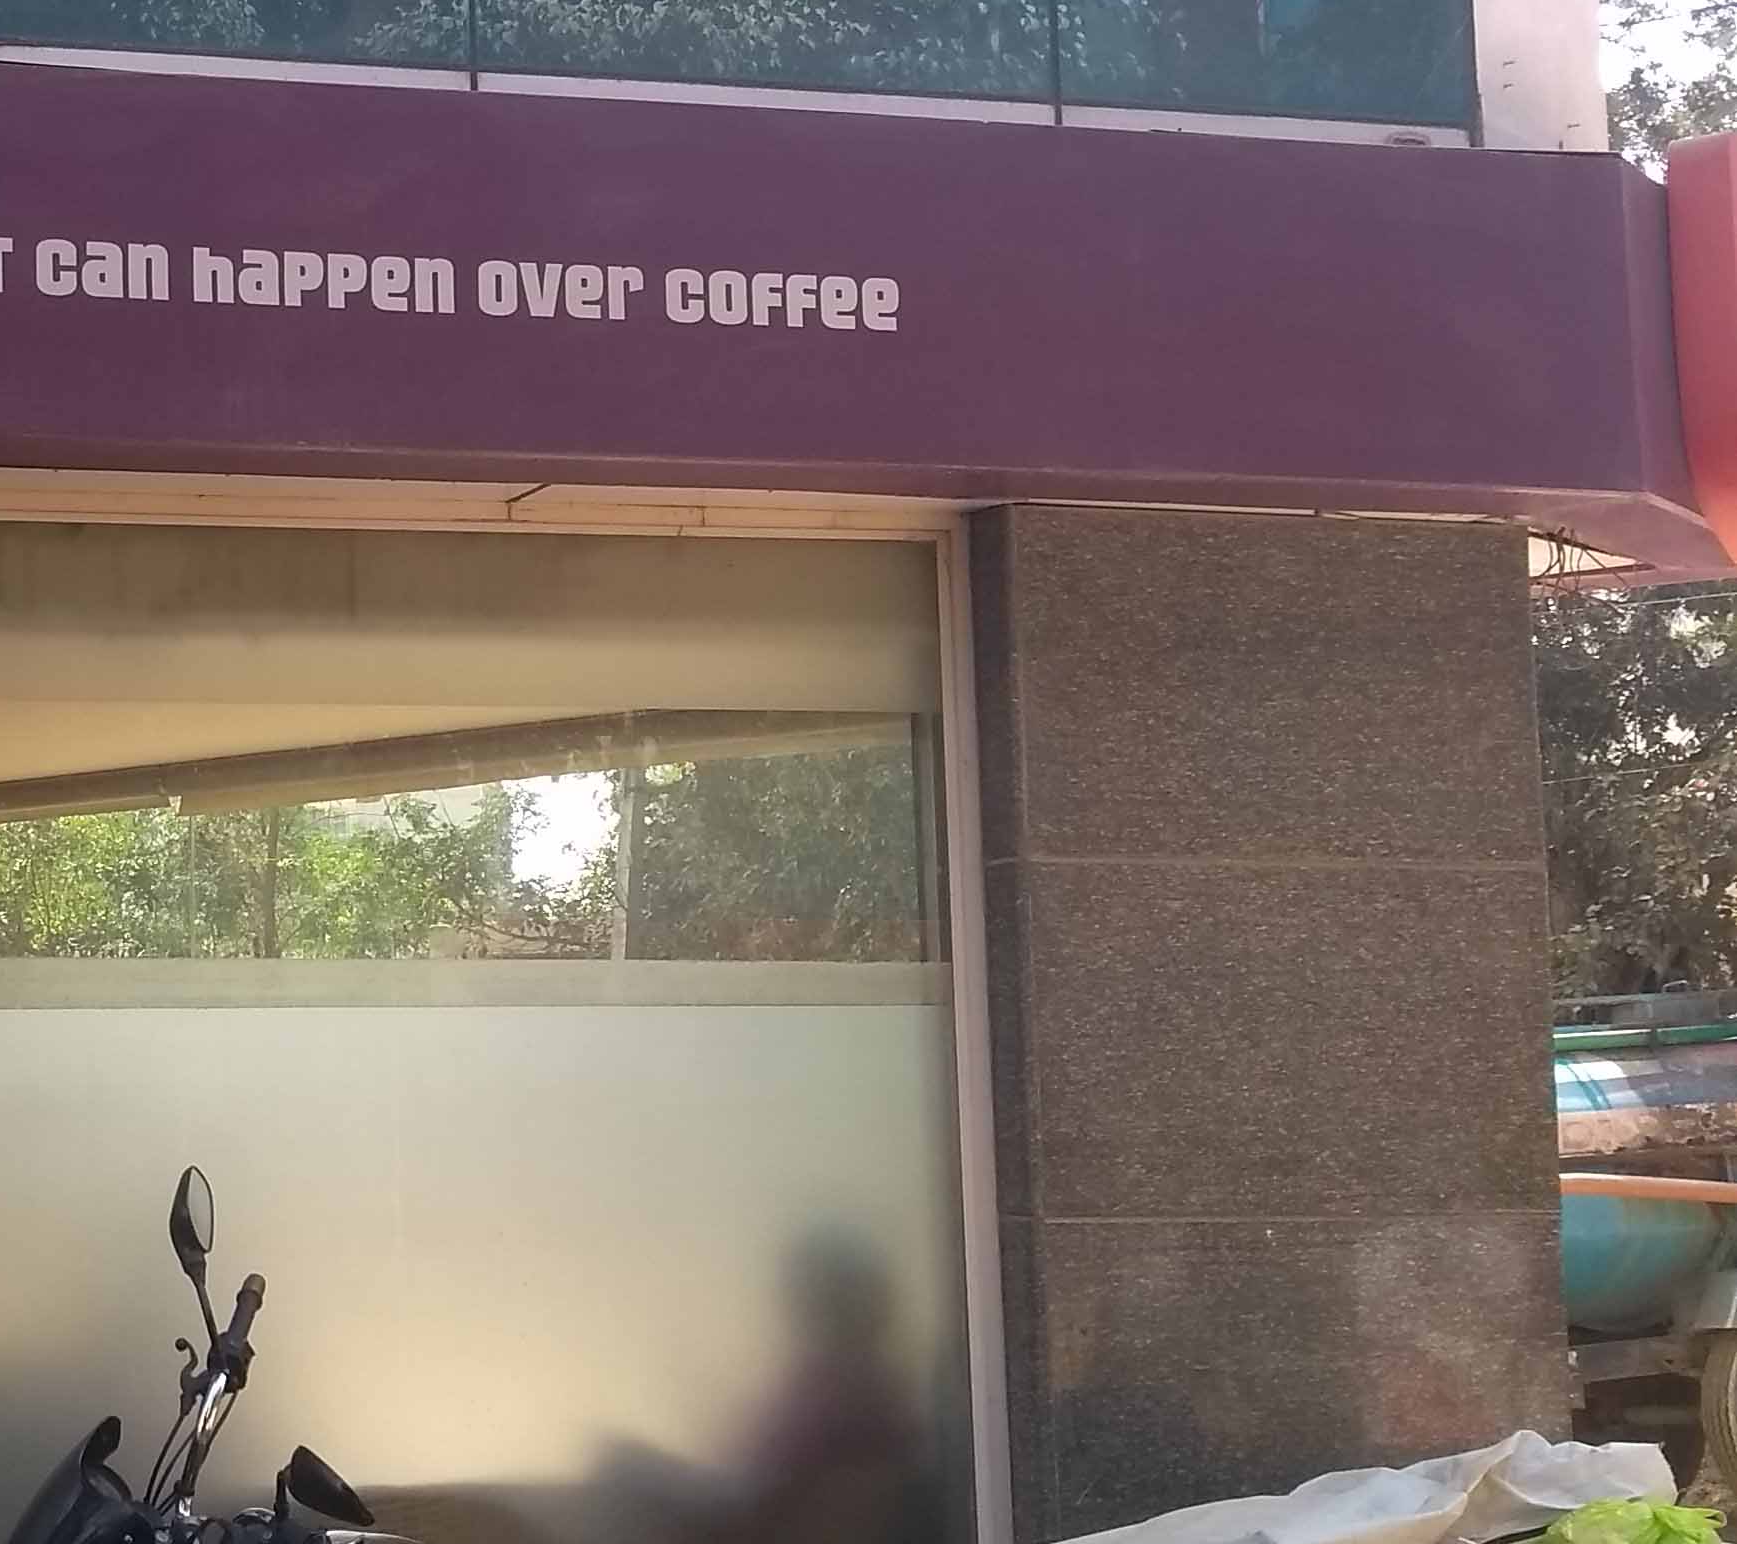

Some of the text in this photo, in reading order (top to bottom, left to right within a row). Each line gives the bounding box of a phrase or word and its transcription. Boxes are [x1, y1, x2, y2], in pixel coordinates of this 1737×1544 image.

[35, 239, 170, 301] can
[192, 246, 456, 314] happen
[477, 260, 644, 321] over
[665, 268, 900, 332] coffee
